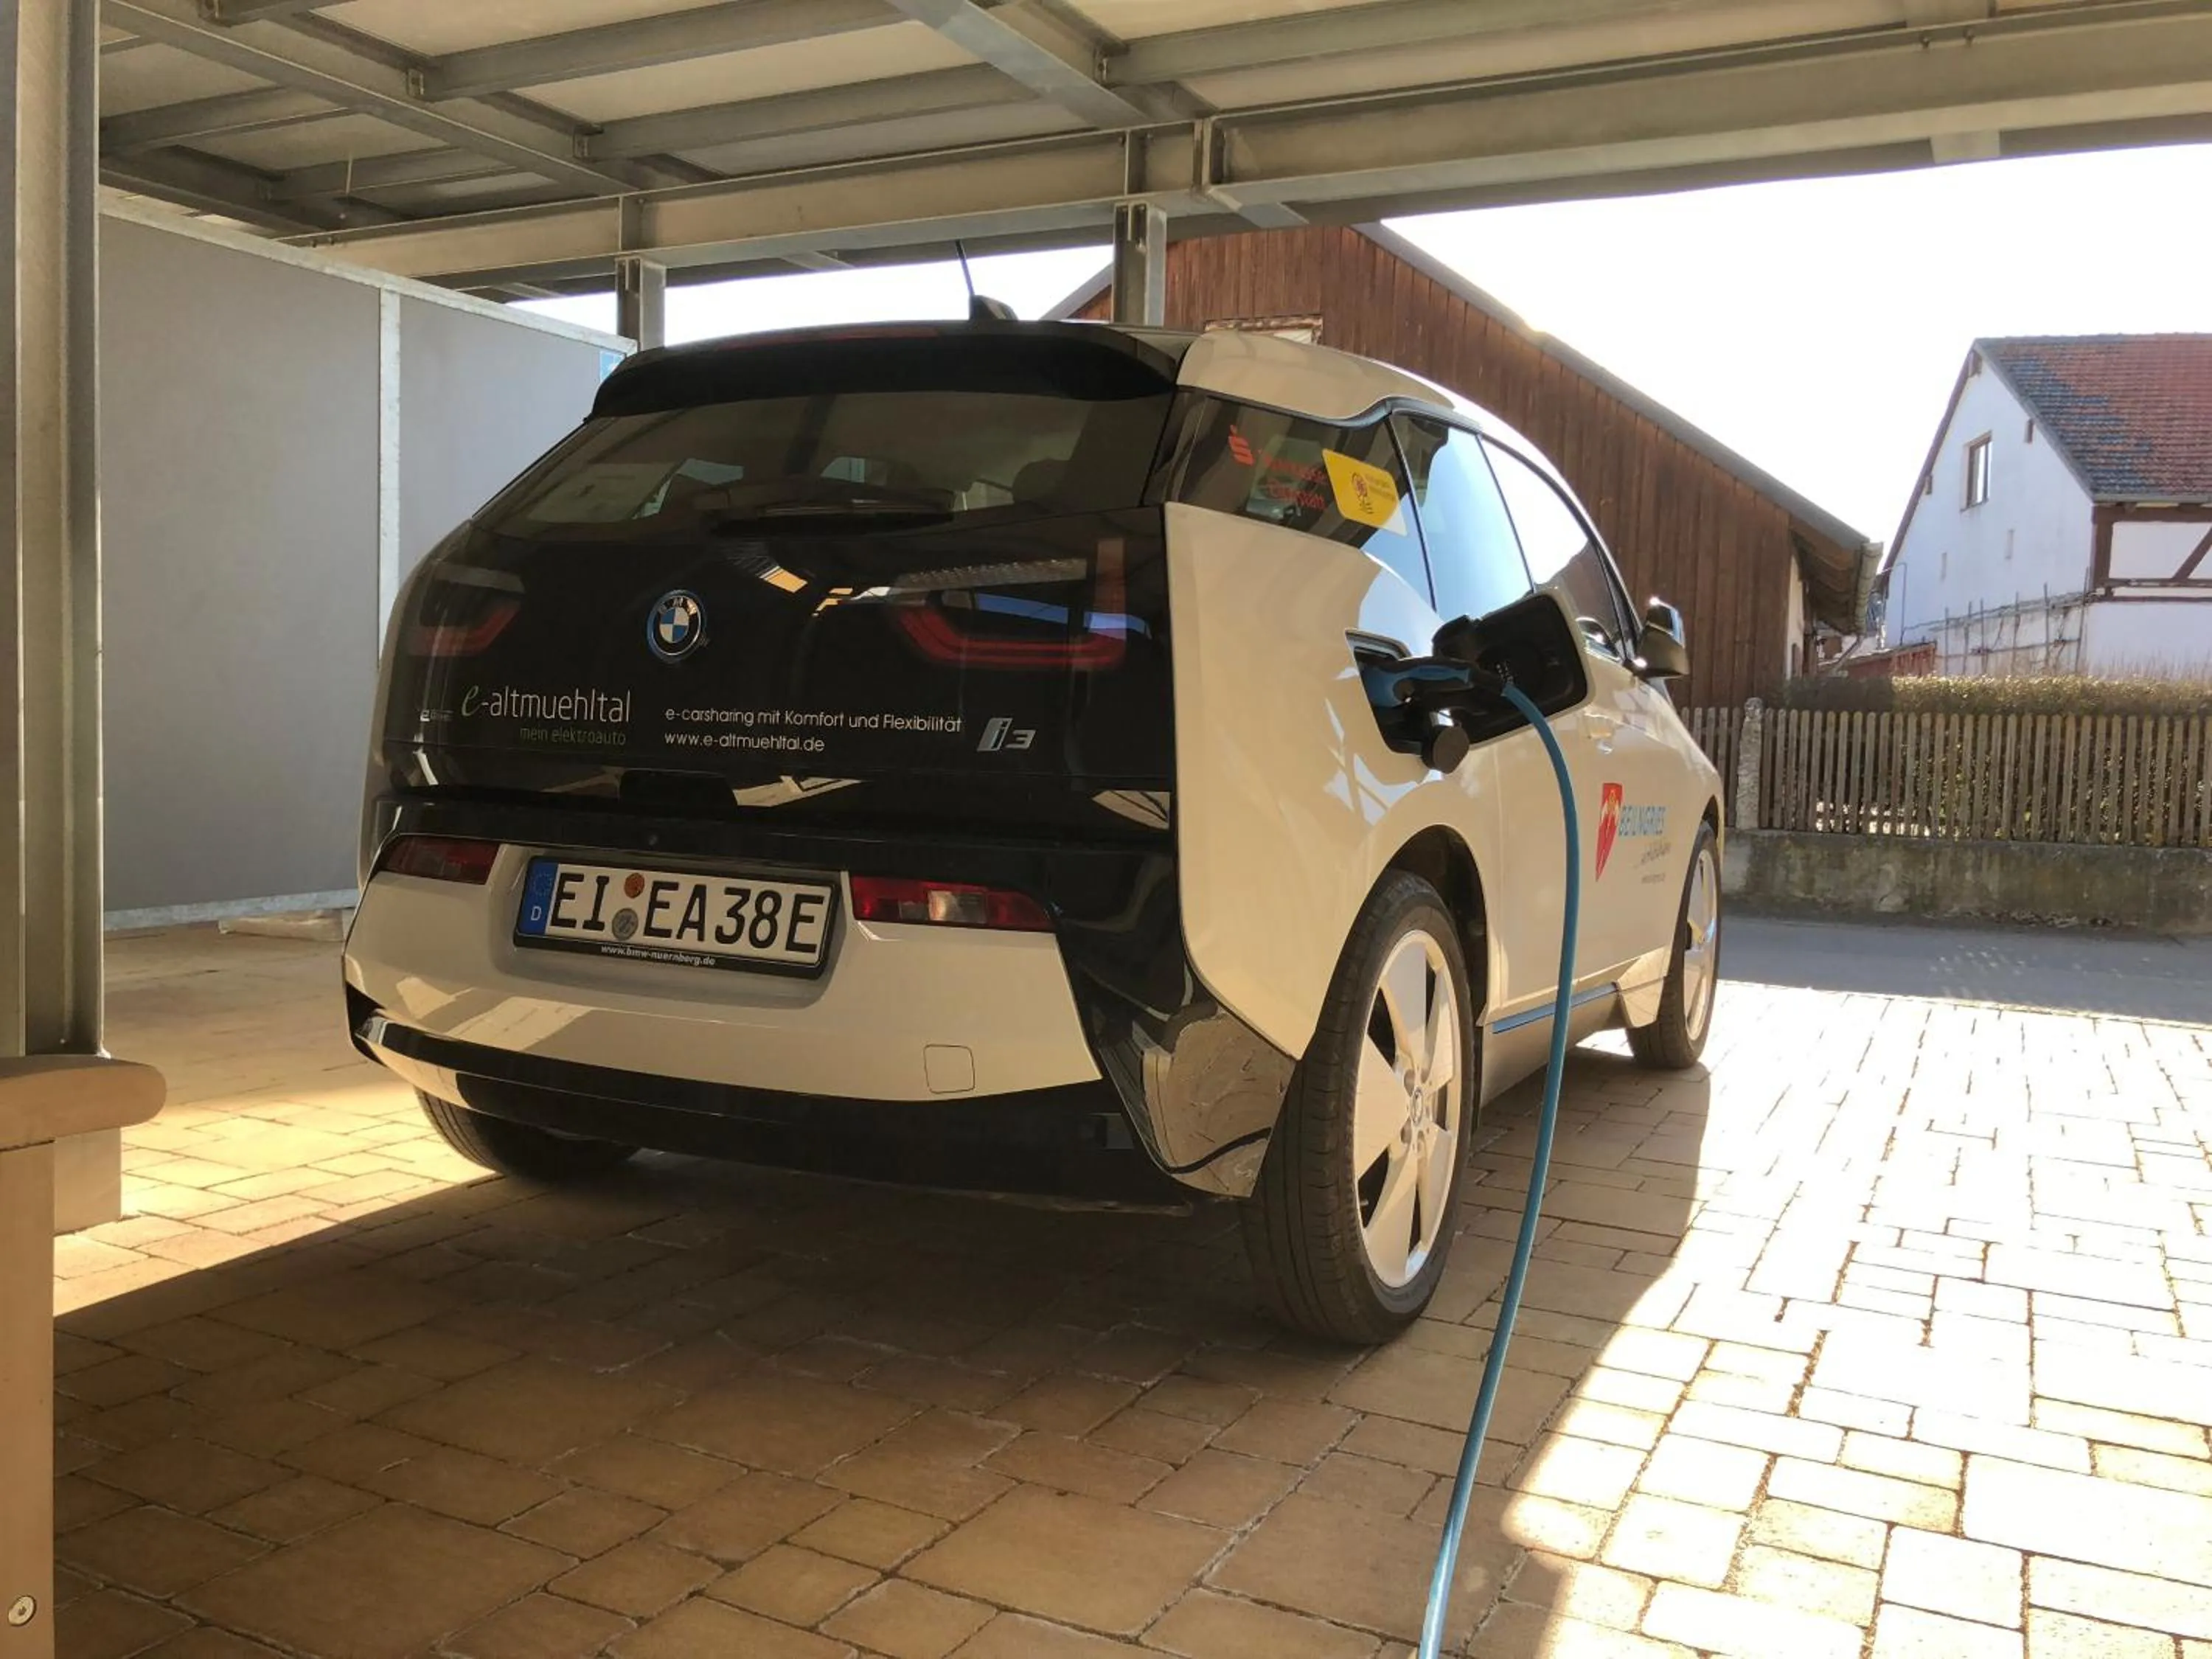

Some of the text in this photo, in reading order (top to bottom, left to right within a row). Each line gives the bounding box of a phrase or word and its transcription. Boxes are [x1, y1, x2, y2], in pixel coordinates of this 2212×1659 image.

[462, 685, 631, 723] e-altmuehltal
[665, 707, 962, 733] e-carsharing mit Komfort und Flexibilität
[520, 726, 627, 745] mein elektroauto
[664, 731, 825, 753] www.e-altmuehltal.de
[530, 905, 542, 922] D
[600, 945, 716, 967] www.bmw-nuernberg.de
